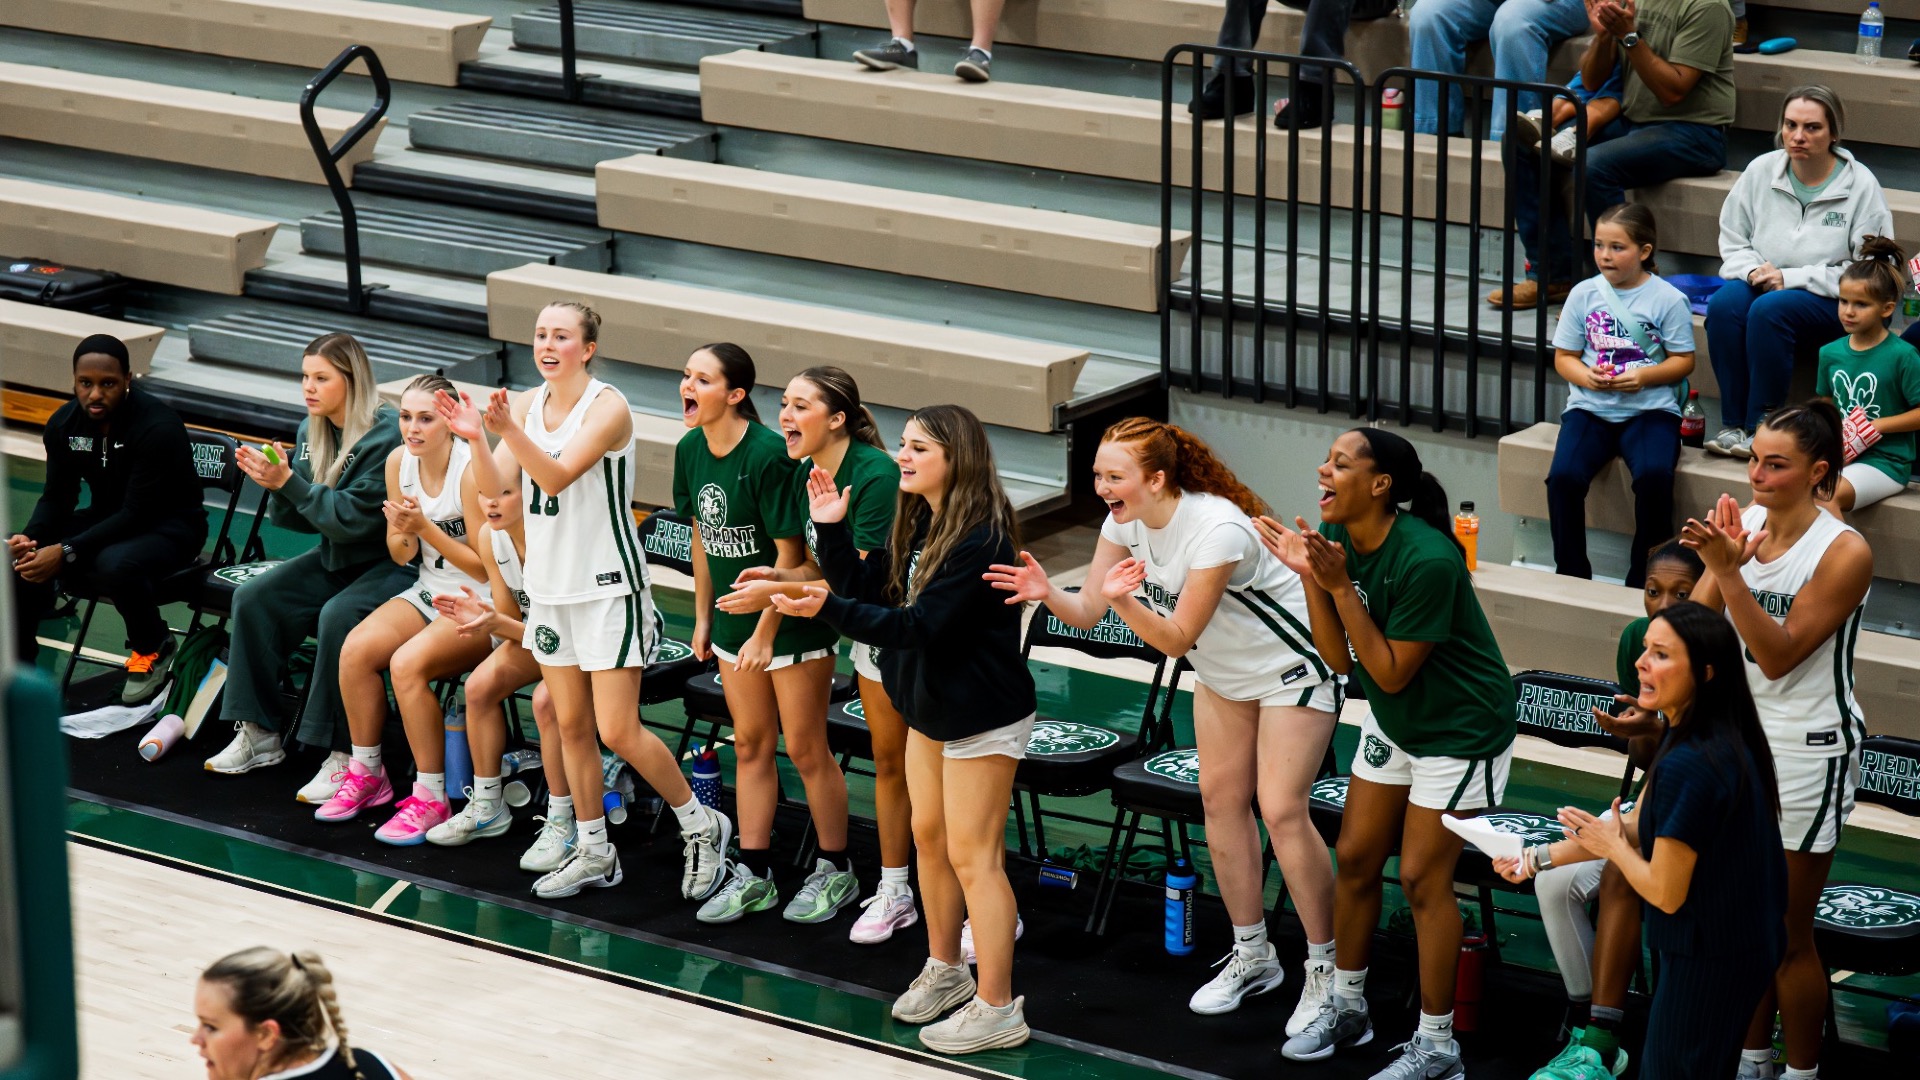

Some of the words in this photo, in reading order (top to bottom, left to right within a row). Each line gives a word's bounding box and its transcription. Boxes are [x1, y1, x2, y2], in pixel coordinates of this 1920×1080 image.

[190, 443, 224, 462] MONT
[654, 518, 692, 543] PIED
[697, 520, 756, 545] EDMONT
[645, 534, 692, 562] UNIVE
[702, 541, 760, 558] KETBALL
[1519, 683, 1615, 715] PIEDMONT
[1860, 749, 1920, 780] PIEDM
[1860, 769, 1920, 800] NIVER
[1185, 889, 1193, 944] POWERADE
